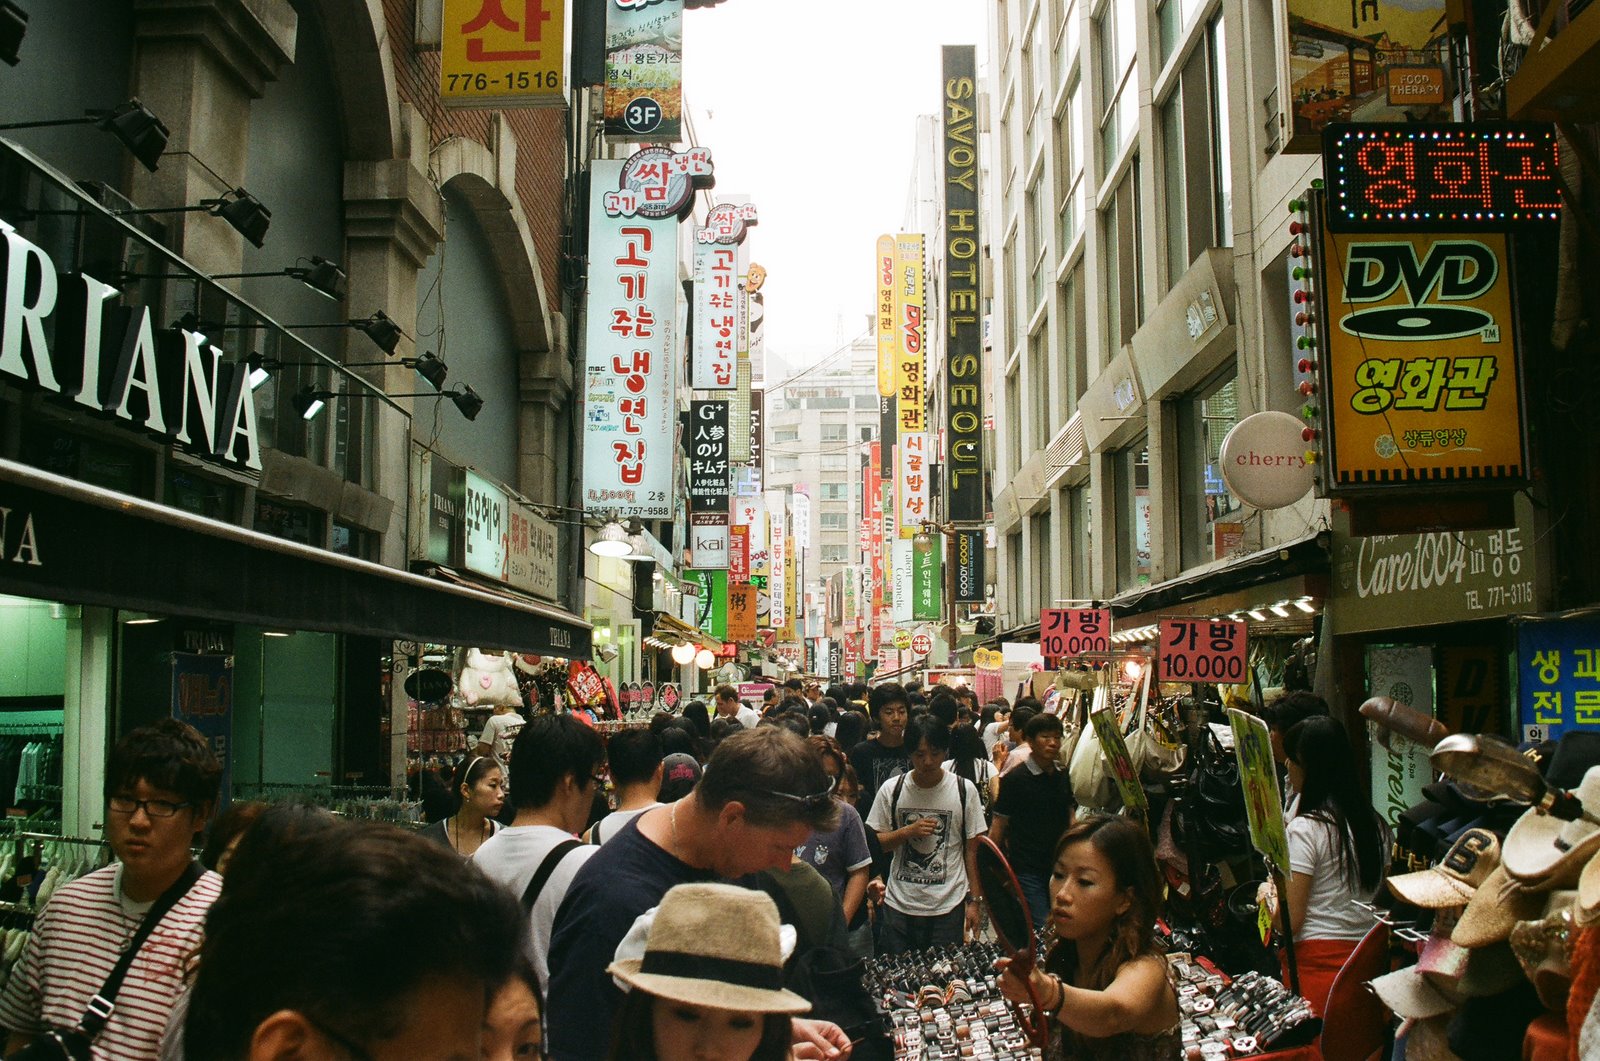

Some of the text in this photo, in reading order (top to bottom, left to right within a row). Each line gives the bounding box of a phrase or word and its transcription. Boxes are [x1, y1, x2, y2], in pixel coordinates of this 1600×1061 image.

[634, 52, 681, 65] 왕돈가스
[447, 71, 558, 92] 776-1516
[608, 69, 633, 81] 정식
[1400, 74, 1429, 85] FOOD
[1390, 85, 1441, 96] THERAPY
[629, 106, 657, 125] 3F
[675, 151, 706, 173] 냉면
[633, 162, 673, 201] 쌈
[607, 195, 636, 212] 고기
[882, 256, 893, 287] DVD
[1342, 240, 1499, 307] DVD
[946, 76, 979, 491] SAVOY HOTEL SEOUL
[880, 289, 893, 331] 영화관
[904, 304, 921, 354] DVD
[1483, 328, 1497, 340] TM
[1350, 355, 1497, 414] 영화관
[901, 361, 921, 430] 영화관
[695, 425, 725, 441] 人参
[1402, 429, 1467, 447] 상류영상
[697, 443, 723, 457] のり
[1236, 450, 1308, 470] cherry
[692, 460, 727, 475] キムチ
[906, 436, 924, 514] 시골밥상
[433, 493, 456, 518] TRIANA
[648, 490, 666, 502] 2층
[705, 498, 717, 506] 1F
[696, 536, 724, 551] kai
[1470, 538, 1486, 575] in
[1488, 527, 1523, 578] 명동
[960, 533, 969, 597] GOODY GOODY
[1047, 611, 1102, 634] 가방
[1042, 636, 1107, 654] 10.000
[1169, 623, 1237, 652] 가방
[1162, 653, 1242, 679] 10.000
